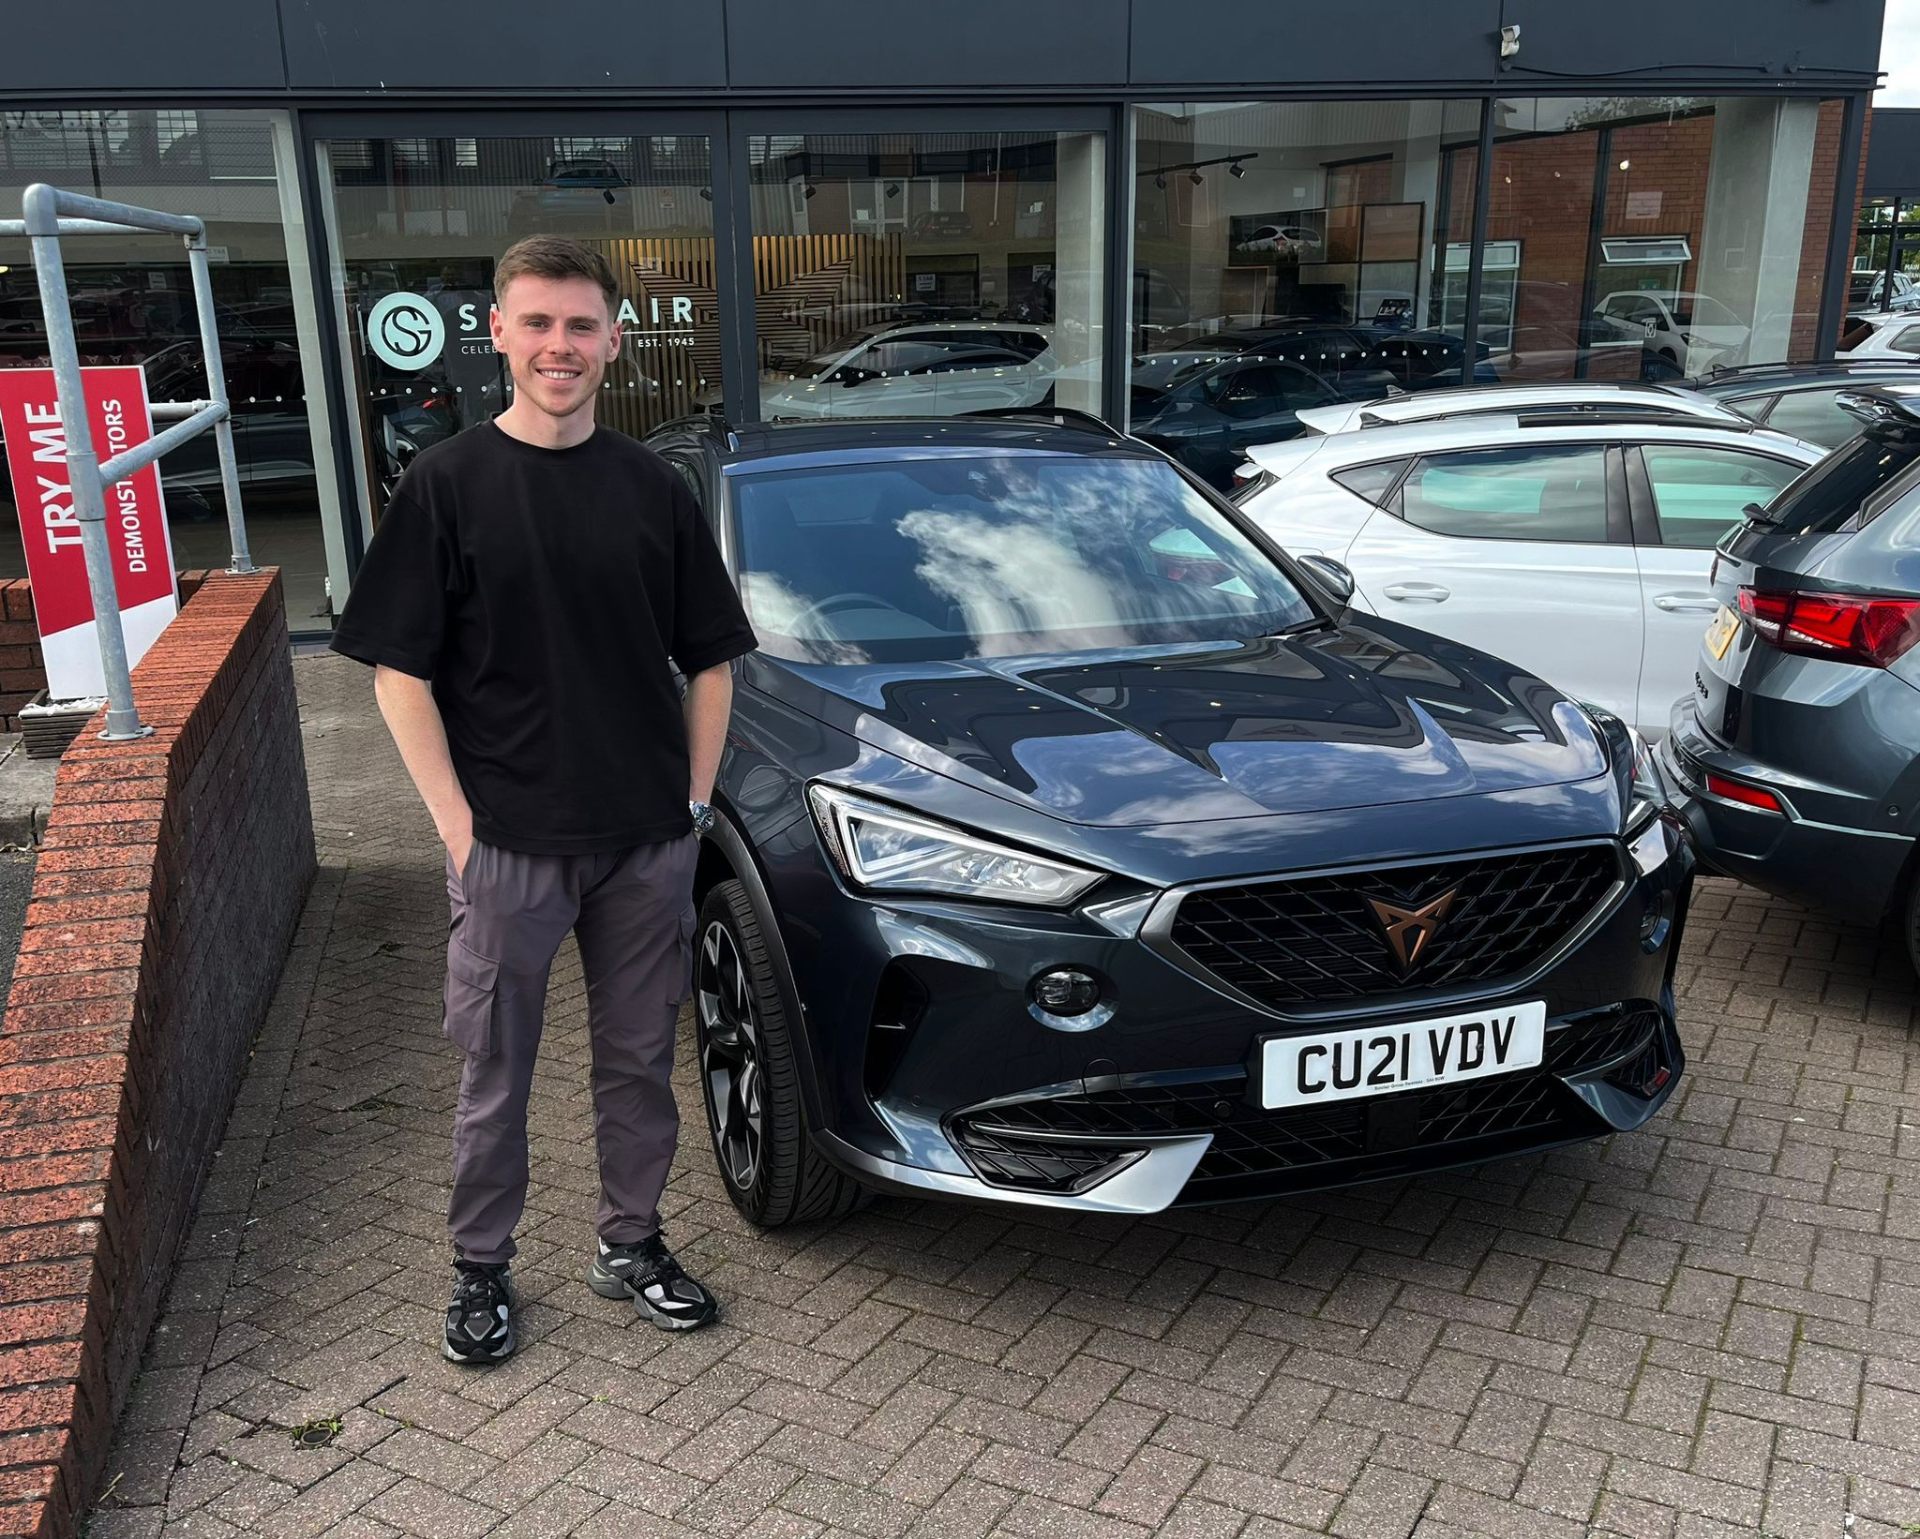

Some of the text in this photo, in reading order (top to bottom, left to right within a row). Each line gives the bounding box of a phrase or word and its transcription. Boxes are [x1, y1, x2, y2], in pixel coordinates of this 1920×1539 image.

[458, 297, 693, 331] SAIR
[638, 338, 662, 348] EST.
[667, 337, 695, 347] 1945
[24, 401, 67, 463] ME
[37, 475, 83, 553] TRY
[102, 398, 147, 573] DEMONSTTORS
[1297, 1016, 1517, 1095] CU21 VDV
